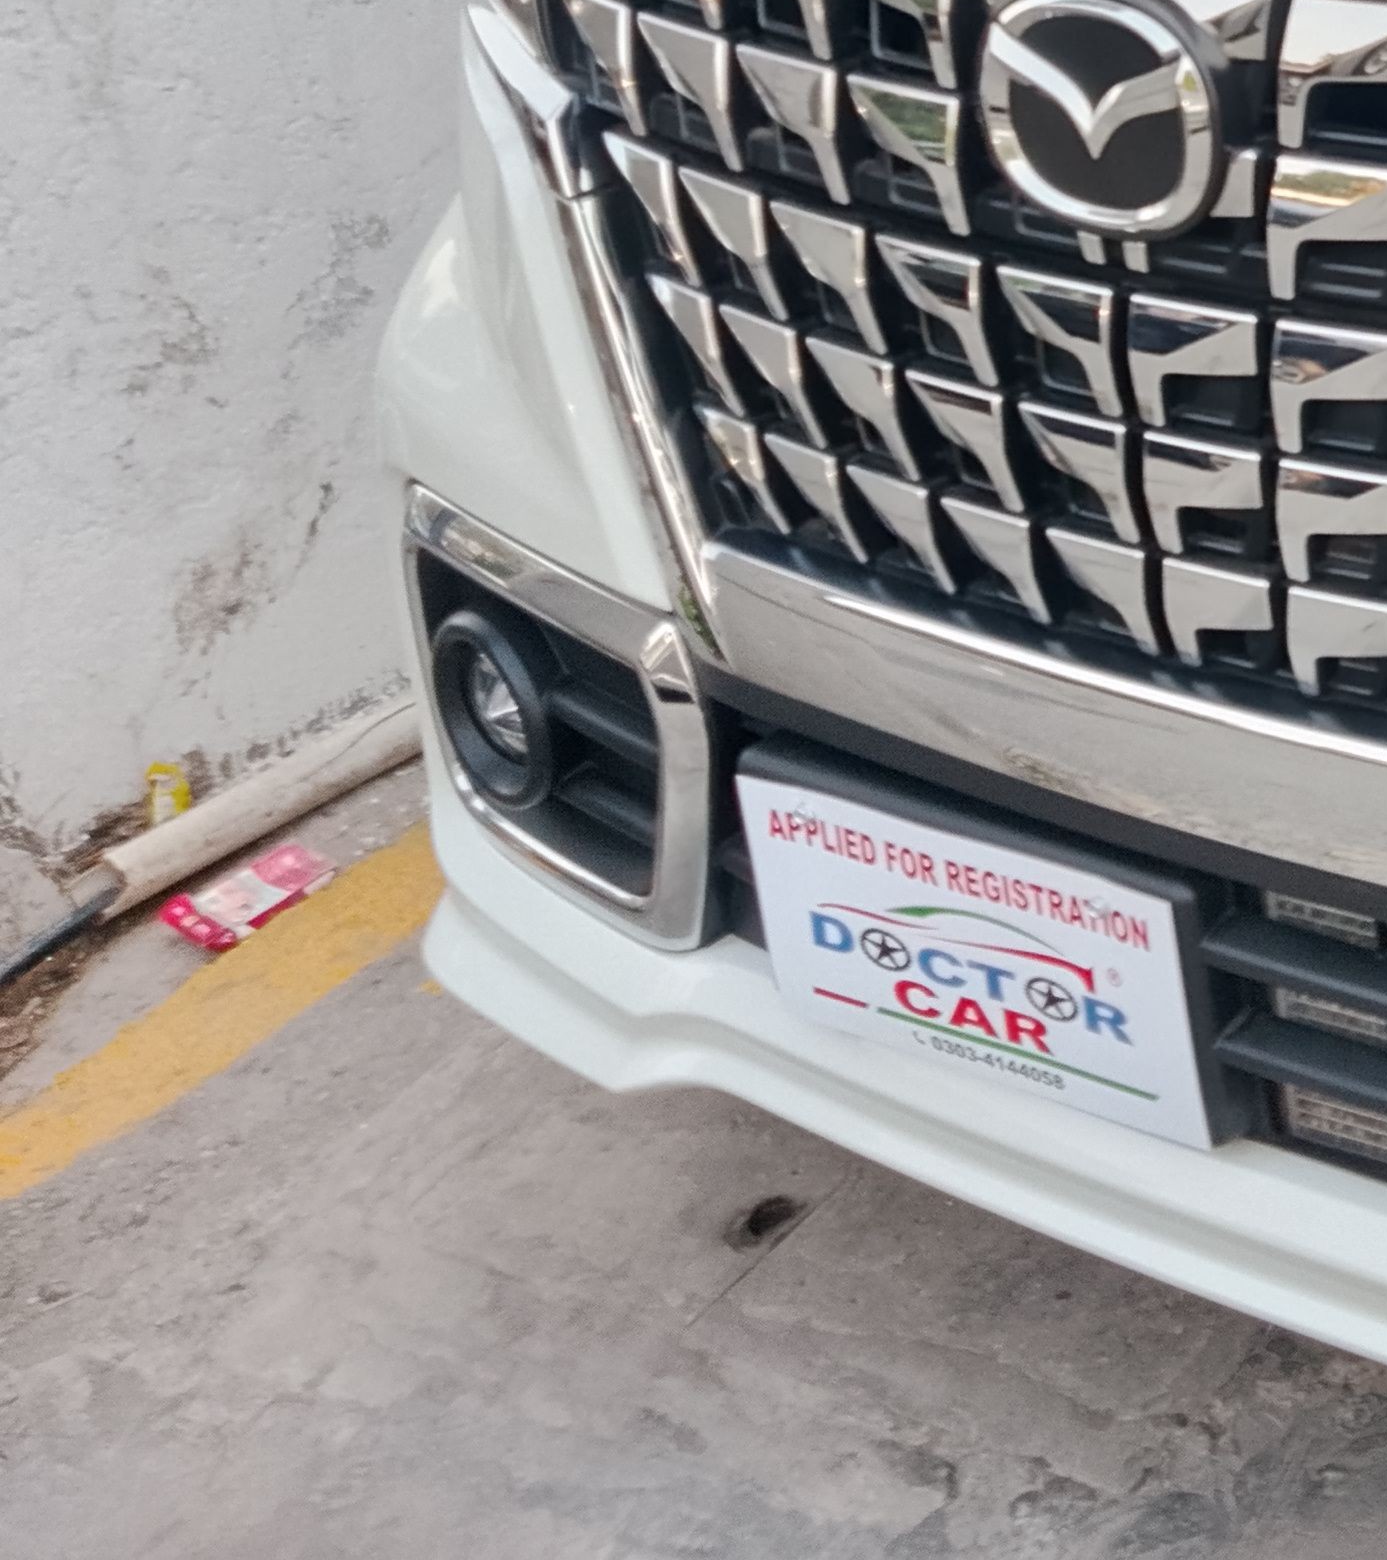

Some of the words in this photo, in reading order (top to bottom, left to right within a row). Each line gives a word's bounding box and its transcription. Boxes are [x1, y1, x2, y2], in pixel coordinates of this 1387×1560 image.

[769, 809, 876, 866] APPLIED
[885, 841, 939, 887] FOR
[944, 860, 1151, 952] REGISTRATION
[810, 911, 1134, 1046] DOCTOR
[893, 980, 1055, 1056] CAR
